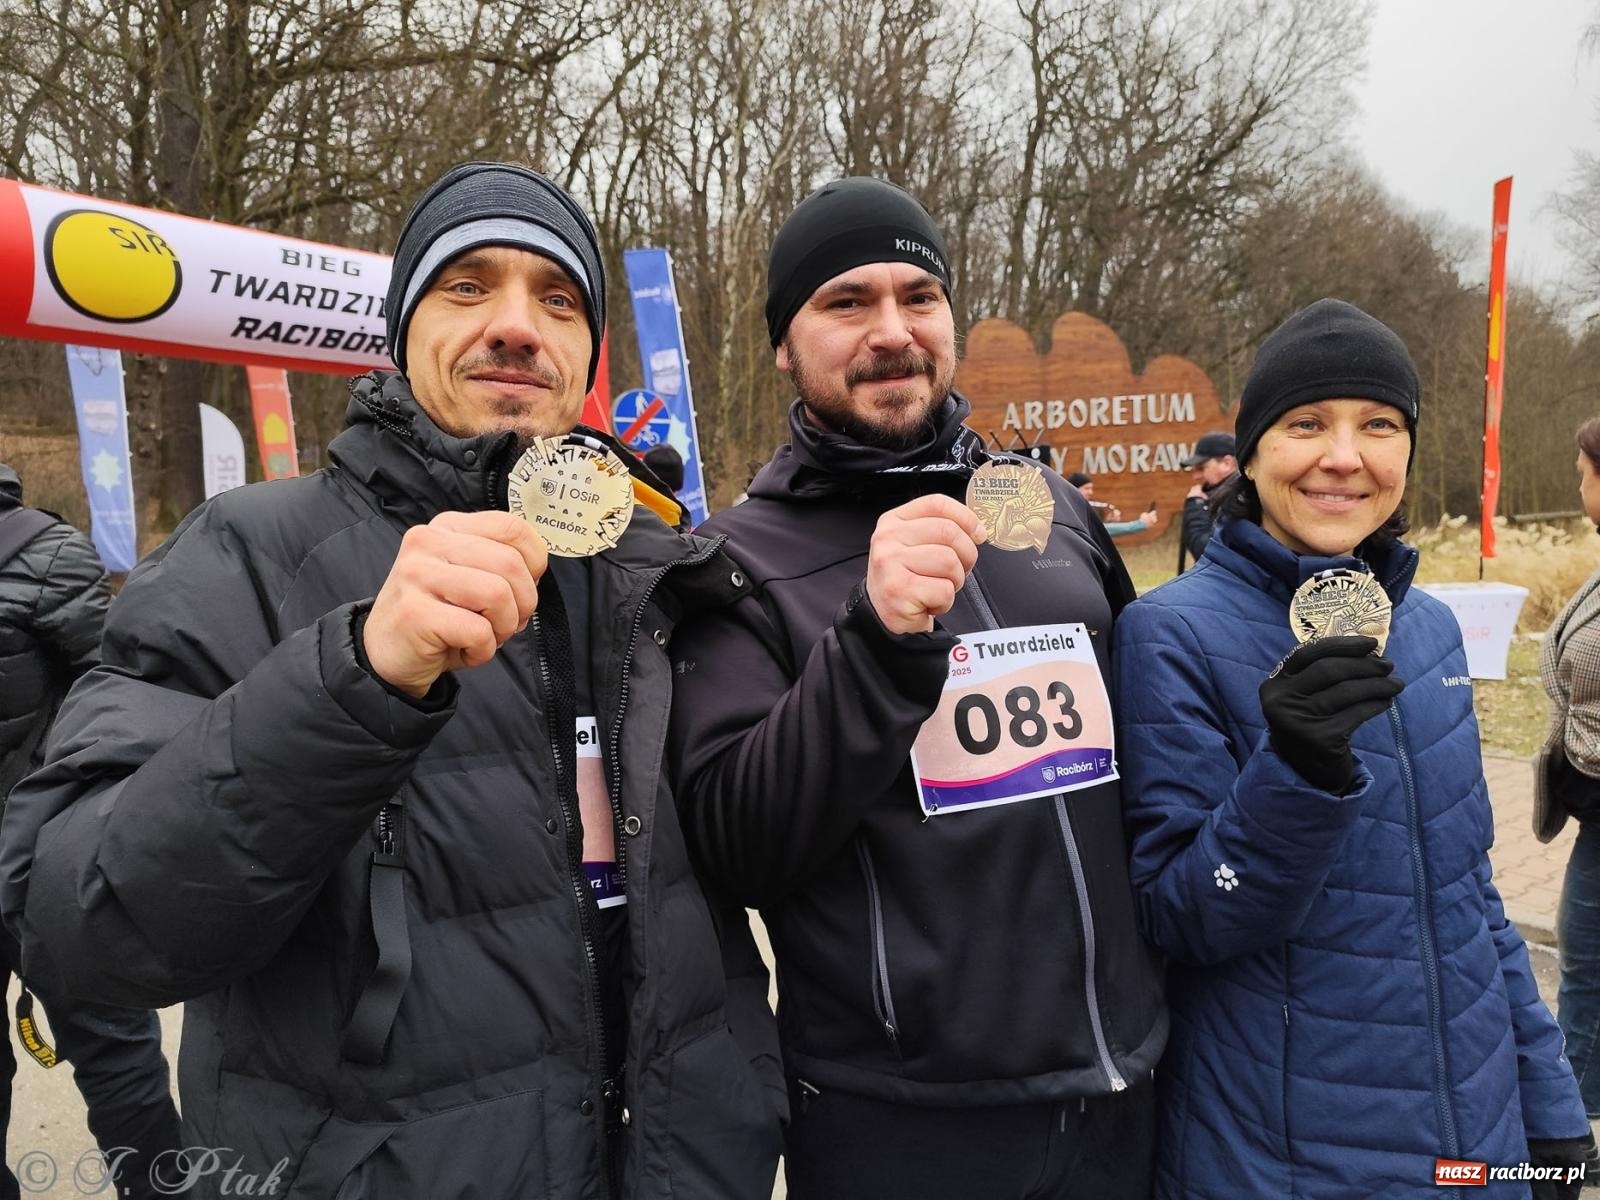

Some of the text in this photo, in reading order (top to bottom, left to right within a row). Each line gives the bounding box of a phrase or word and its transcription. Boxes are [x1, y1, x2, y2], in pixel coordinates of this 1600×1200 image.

[281, 247, 361, 277] BIEG
[895, 238, 945, 274] KIPRUN
[230, 315, 391, 357] RACIBÓR
[1002, 392, 1196, 431] ARBORETUM
[973, 477, 1018, 488] 13 BIEG
[569, 488, 600, 505] OSiR
[535, 514, 588, 536] RACIBÓRZ
[1312, 590, 1347, 602] BIEG
[973, 633, 1075, 660] Twardziela
[951, 667, 972, 677] 2025
[954, 681, 1083, 756] 083
[1056, 761, 1094, 777] Racibórz
